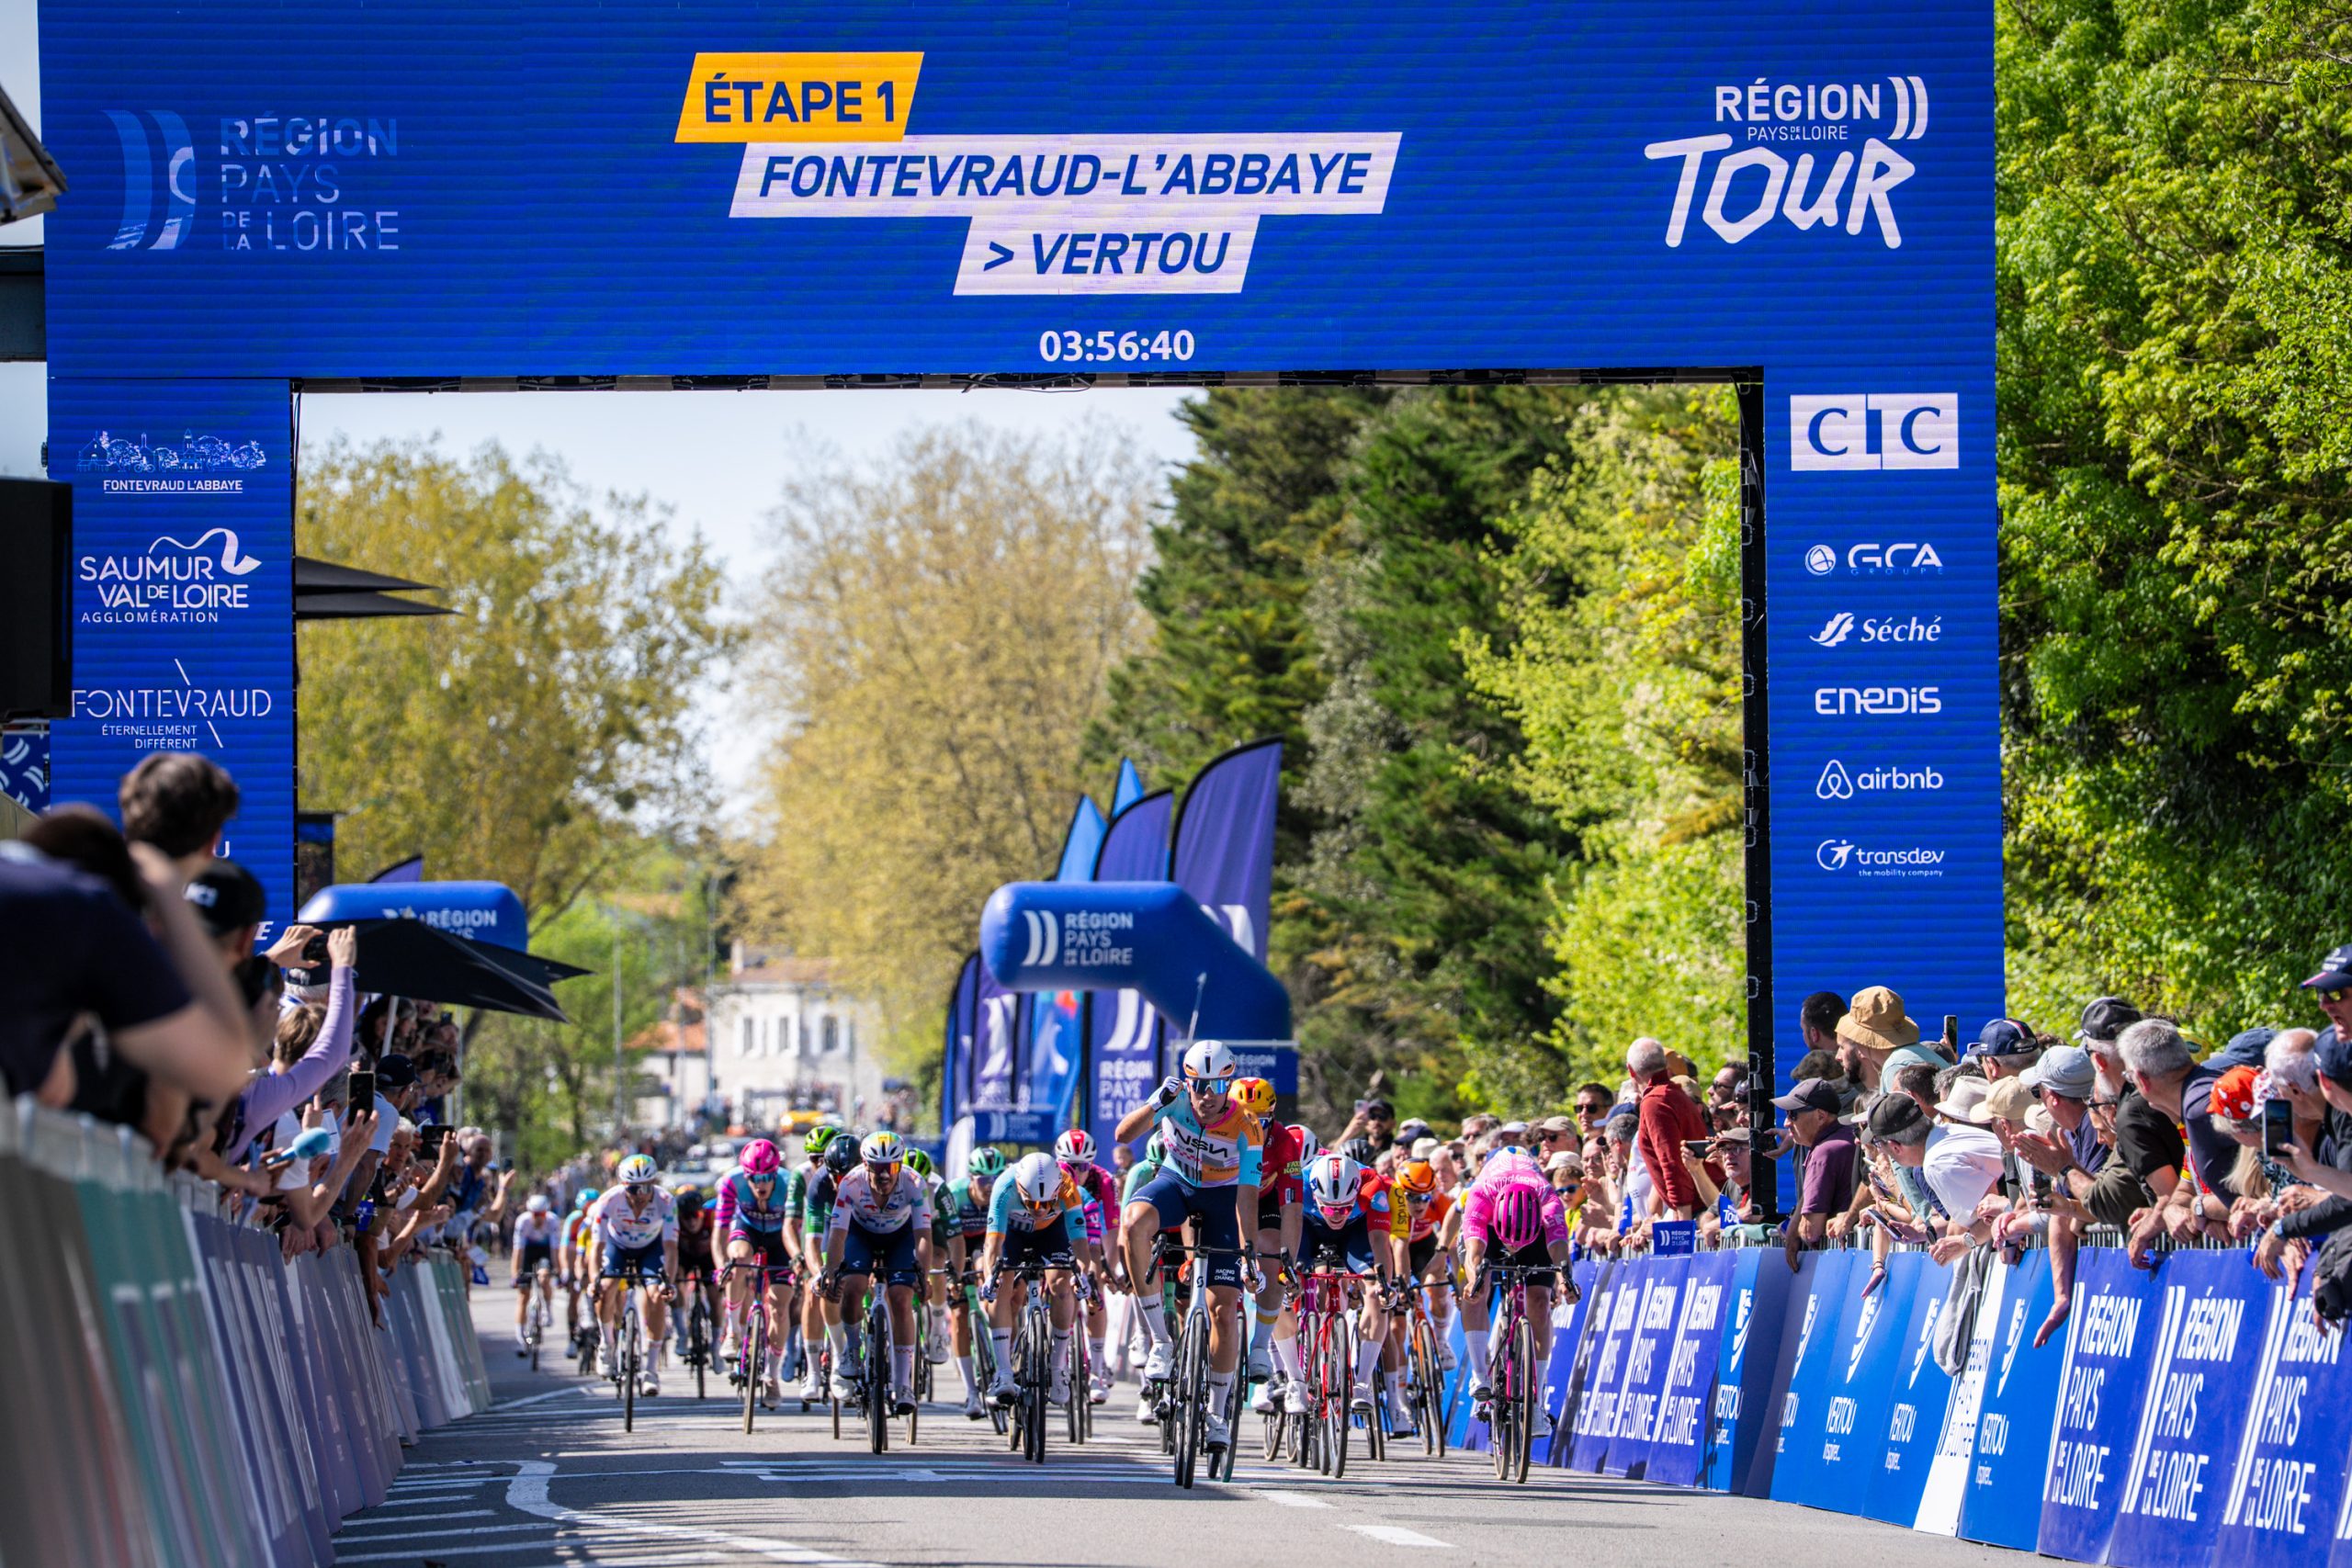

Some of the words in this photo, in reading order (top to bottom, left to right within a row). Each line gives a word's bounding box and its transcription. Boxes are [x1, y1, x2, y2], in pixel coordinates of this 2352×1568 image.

[705, 73, 863, 123] ÉTAPE
[876, 80, 894, 122] 1
[1715, 77, 1881, 122] RÉGION
[220, 110, 397, 156] RÉGION
[1748, 127, 1789, 141] PAYS
[1803, 125, 1849, 141] LOIRE
[220, 164, 340, 204] PAYS
[759, 152, 1372, 197] FONTEVRAUD-L'ABBAYE
[1645, 133, 1916, 249] TOUR
[222, 211, 251, 229] DE
[266, 211, 399, 251] LOIRE
[222, 233, 251, 251] LA
[1033, 231, 1232, 276] VERTOU
[1039, 329, 1195, 363] 03:56:40
[103, 479, 186, 491] FONTEVRAUD
[187, 479, 243, 491] L'ABBAYE
[80, 556, 214, 581] SAUMUR
[1847, 542, 1943, 568] GCA
[97, 584, 149, 609] VAL
[148, 584, 169, 599] DE
[173, 583, 249, 609] LOIRE
[81, 610, 219, 623] AGGLOMÉRATION
[1860, 615, 1941, 643] Séché
[72, 689, 272, 717] FONTEVRAUD
[102, 724, 197, 736] ÉTERNELLEMENT
[135, 737, 198, 750] DIFFÉRENT
[1858, 765, 1943, 791] airbnb
[1856, 847, 1945, 865] transdev
[1859, 868, 1870, 876] the
[1872, 868, 1905, 878] mobility
[1906, 869, 1944, 878] company
[426, 908, 497, 927] RÉGION
[1064, 909, 1134, 929] RÉGION
[1064, 930, 1112, 948] PAYS
[1080, 947, 1133, 965] LOIRE
[1099, 1080, 1142, 1100] PAYS
[1644, 1277, 1678, 1330] RÉGION
[1687, 1277, 1722, 1330] RÉGION
[2078, 1282, 2143, 1359] RÉGION
[2177, 1285, 2245, 1362] RÉGION
[1631, 1338, 1656, 1385] PAYS
[1673, 1340, 1701, 1387] PAYS
[1714, 1384, 1744, 1420] VERTOU
[1826, 1396, 1857, 1435] VERTOU
[2064, 1366, 2105, 1431] PAYS
[2157, 1372, 2204, 1440] PAYS
[2260, 1376, 2308, 1448] PAYS
[1626, 1393, 1657, 1441] LOIRE
[1668, 1396, 1701, 1445] LOIRE
[1889, 1403, 1917, 1443] VERTOU
[1979, 1413, 2009, 1456] VERTOU
[2057, 1440, 2068, 1468] DE
[2148, 1450, 2162, 1478] DE
[2052, 1476, 2062, 1503] LA
[2060, 1441, 2110, 1510] LOIRE
[2153, 1450, 2210, 1522] LOIRE
[2252, 1458, 2266, 1487] DE
[2141, 1487, 2154, 1516] LA
[2244, 1496, 2256, 1527] LA
[2256, 1458, 2316, 1535] LOIRE
